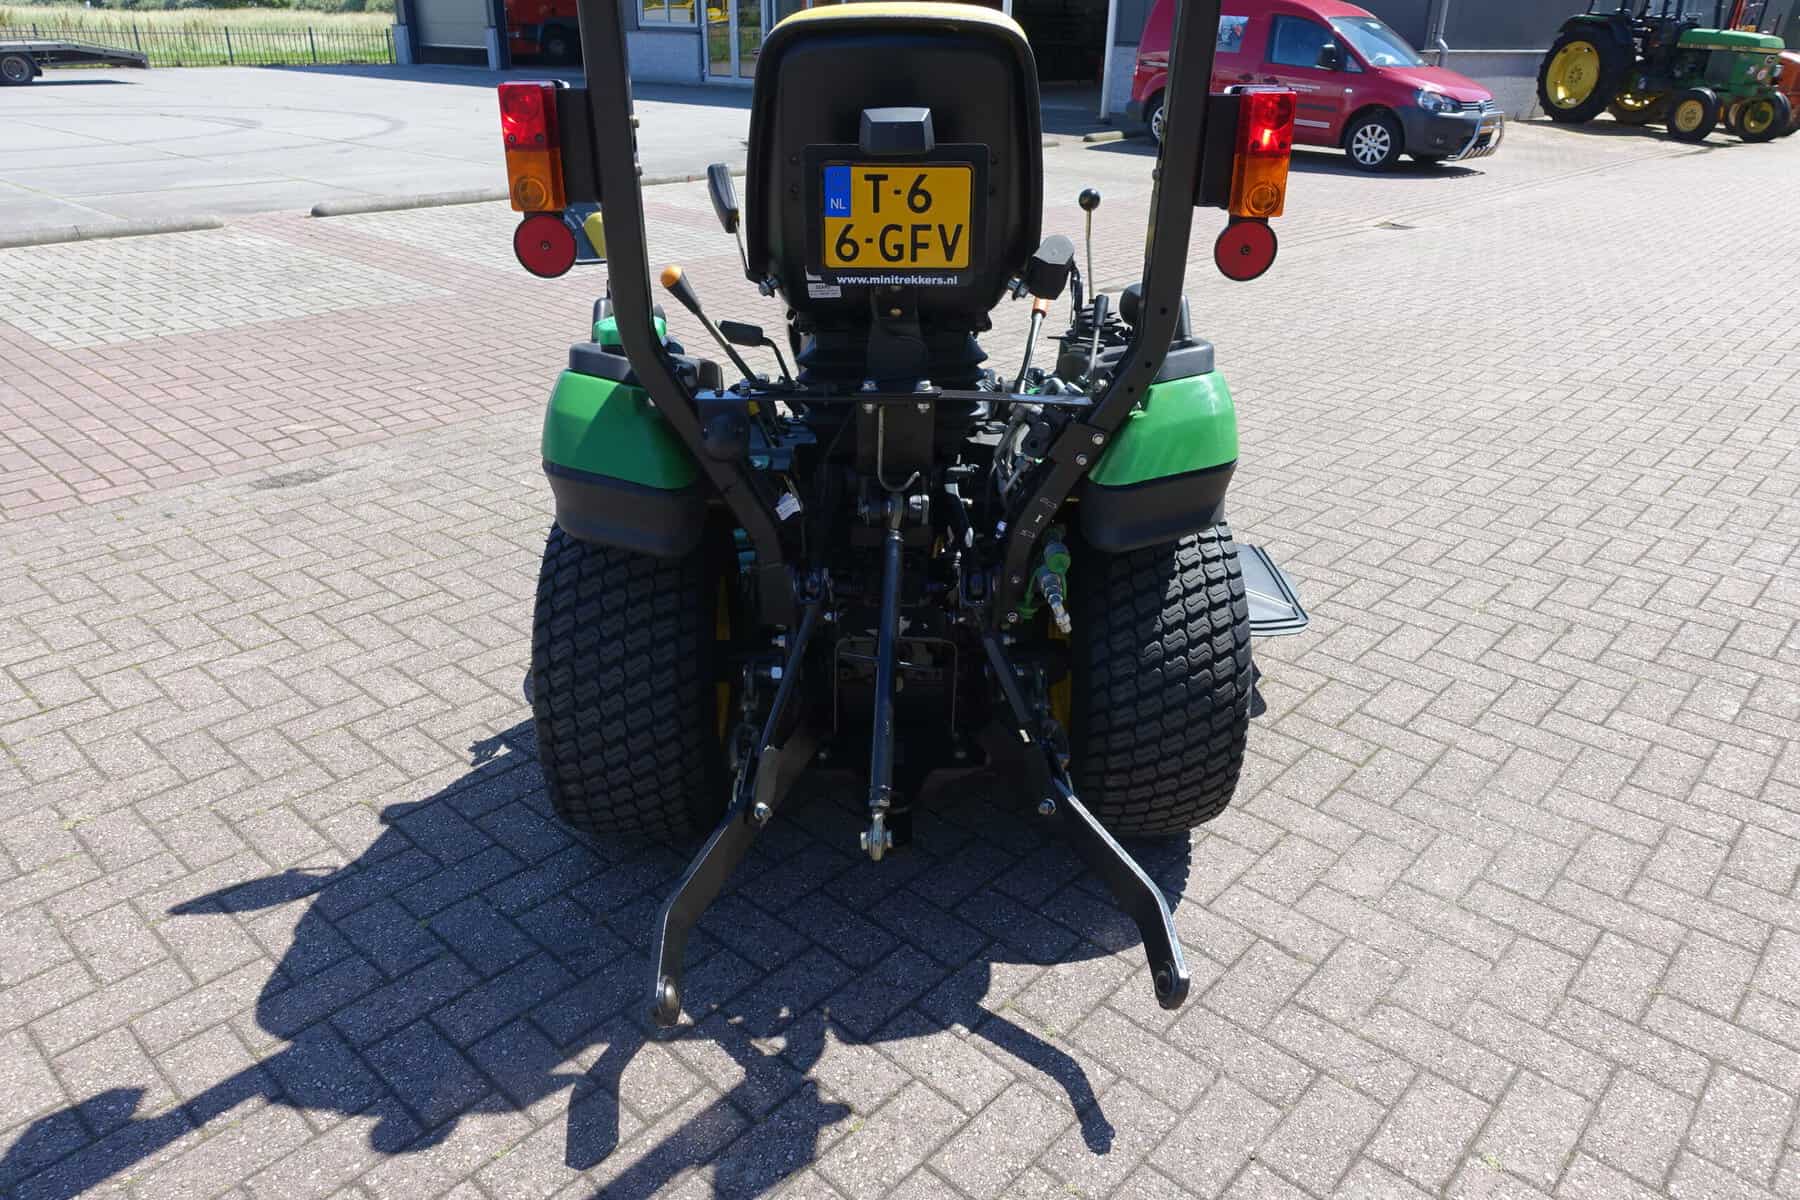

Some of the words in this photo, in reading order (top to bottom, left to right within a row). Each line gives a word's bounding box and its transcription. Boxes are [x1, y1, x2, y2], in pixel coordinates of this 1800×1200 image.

[830, 198, 847, 210] NL
[863, 174, 932, 214] T-6
[835, 223, 963, 262] 6-GFV
[836, 275, 958, 285] www.minitrekkers.nl
